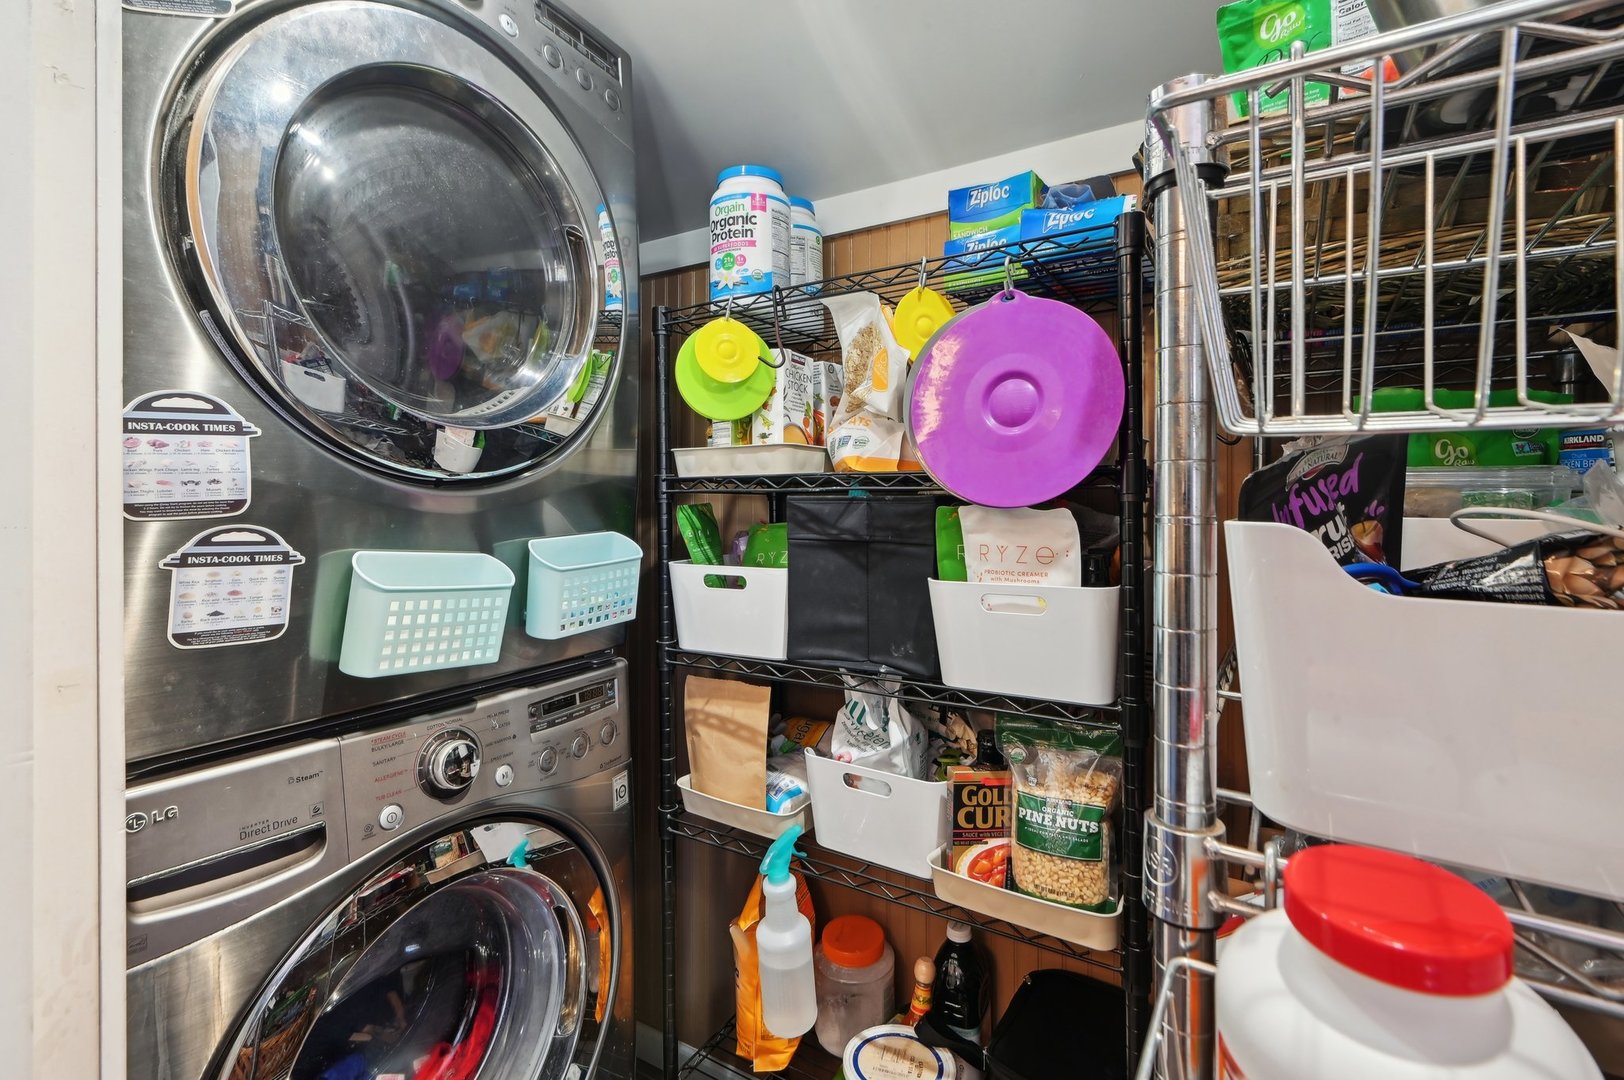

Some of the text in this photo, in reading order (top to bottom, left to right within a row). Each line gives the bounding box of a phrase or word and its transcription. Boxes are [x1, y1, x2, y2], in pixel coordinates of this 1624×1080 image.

[1338, 1, 1365, 14] Calor
[968, 183, 1010, 208] Ziploc
[714, 201, 746, 217] Orgain
[710, 212, 757, 233] Organic
[1047, 208, 1096, 229] Ziploc
[711, 226, 754, 245] Protein
[784, 367, 813, 384] CHICKEN
[787, 380, 808, 394] STOCK
[127, 421, 236, 433] INSTA-COOK TIMES
[1563, 434, 1605, 445] KIRKLAND
[187, 554, 283, 564] INSTA-COOK TIMES
[984, 568, 1049, 578] PROBIOTIC CREAMER
[372, 756, 396, 767] SANITARY
[151, 805, 179, 825] LG
[957, 806, 1012, 829] CUR
[1041, 805, 1074, 818] ORGANIC
[1018, 806, 1100, 834] PINE NUTS
[239, 815, 298, 842] Direct Drive
